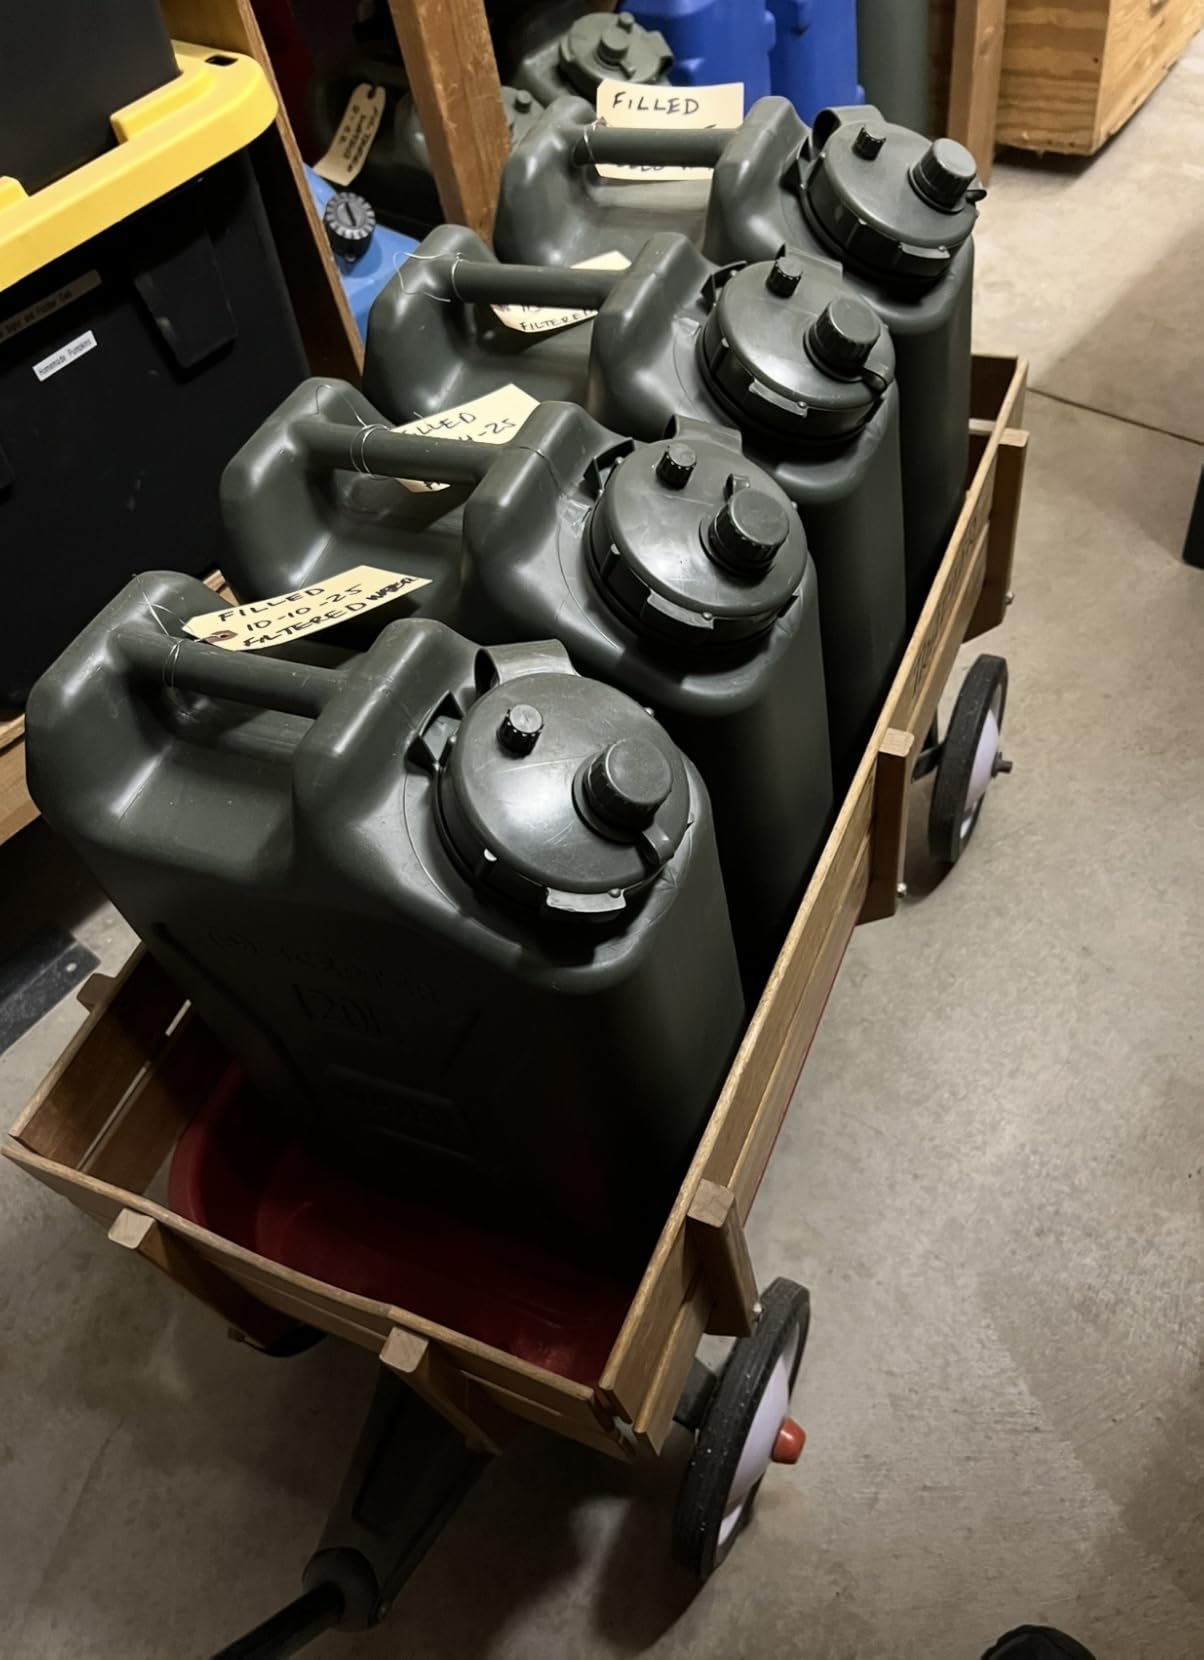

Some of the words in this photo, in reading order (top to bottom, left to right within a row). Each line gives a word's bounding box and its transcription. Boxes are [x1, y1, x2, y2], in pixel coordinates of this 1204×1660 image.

[612, 90, 700, 116] FILLED
[218, 587, 325, 622] FILLED
[242, 601, 367, 646] FILTERED
